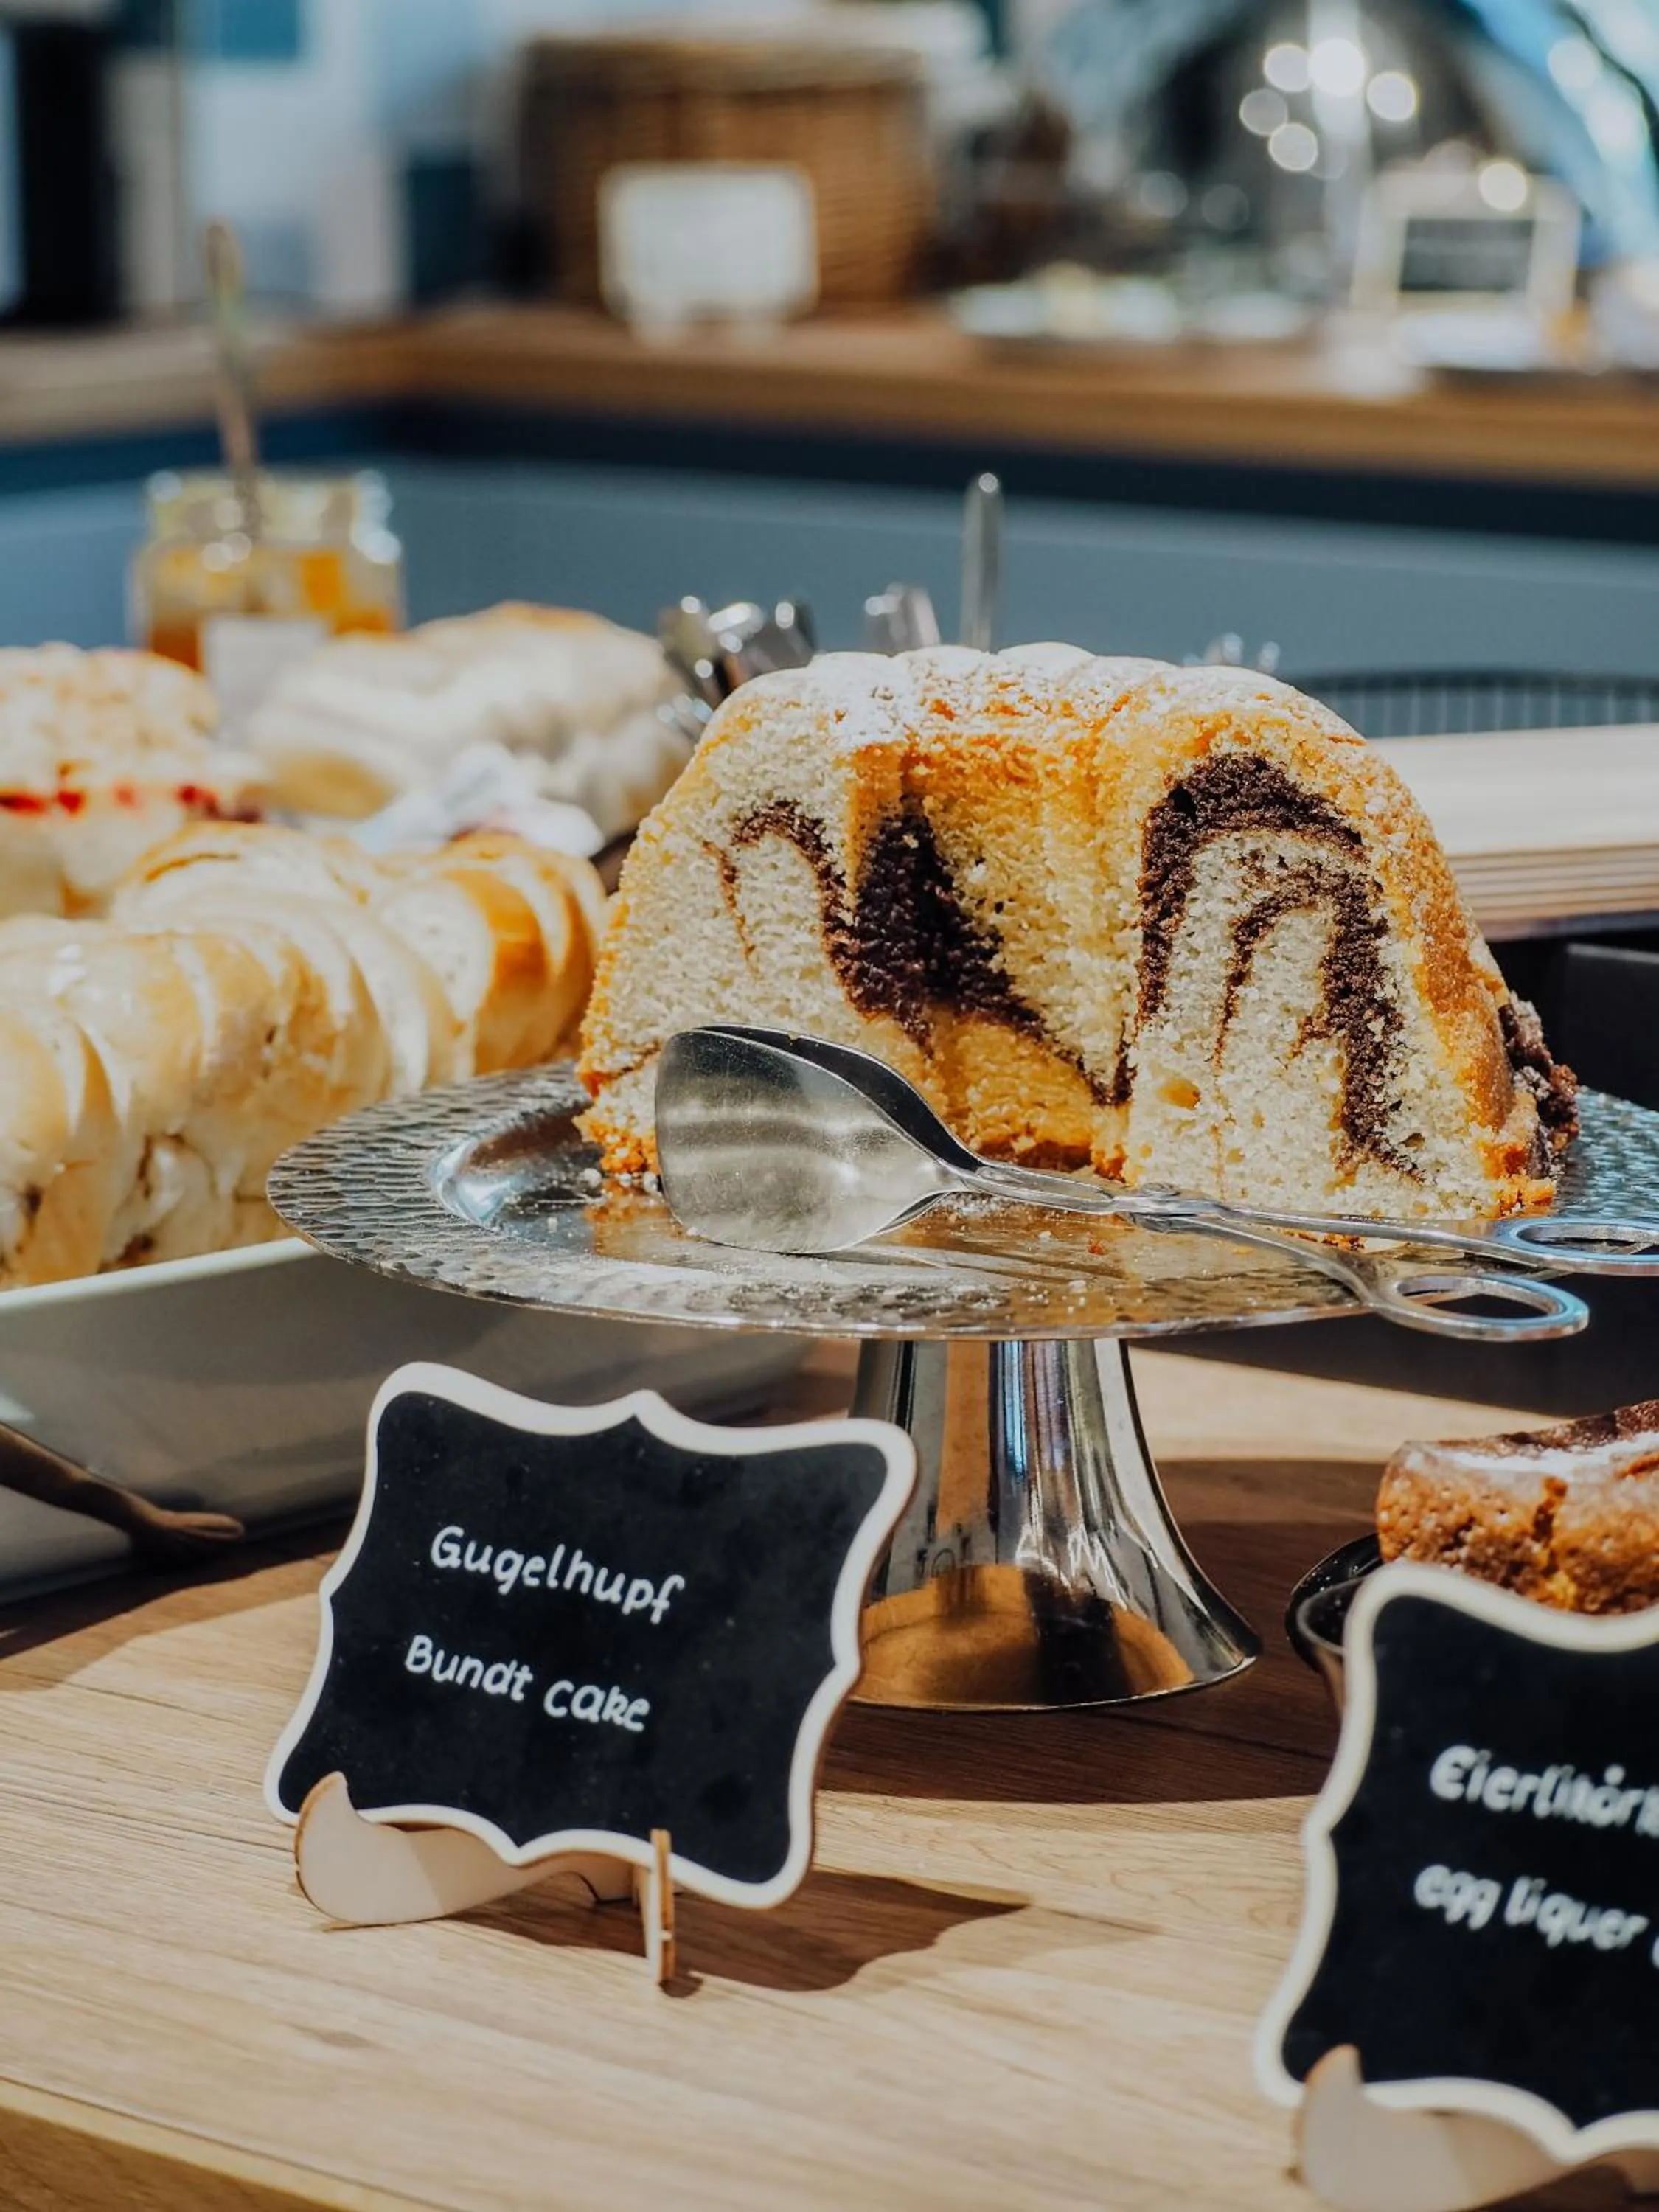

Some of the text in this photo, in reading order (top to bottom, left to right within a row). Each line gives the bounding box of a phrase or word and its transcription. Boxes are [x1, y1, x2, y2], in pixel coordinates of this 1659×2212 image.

[430, 1525, 686, 1624] Gugelhupf
[404, 1634, 650, 1733] Bundt cake
[1413, 1864, 1649, 1950] egg liquer
